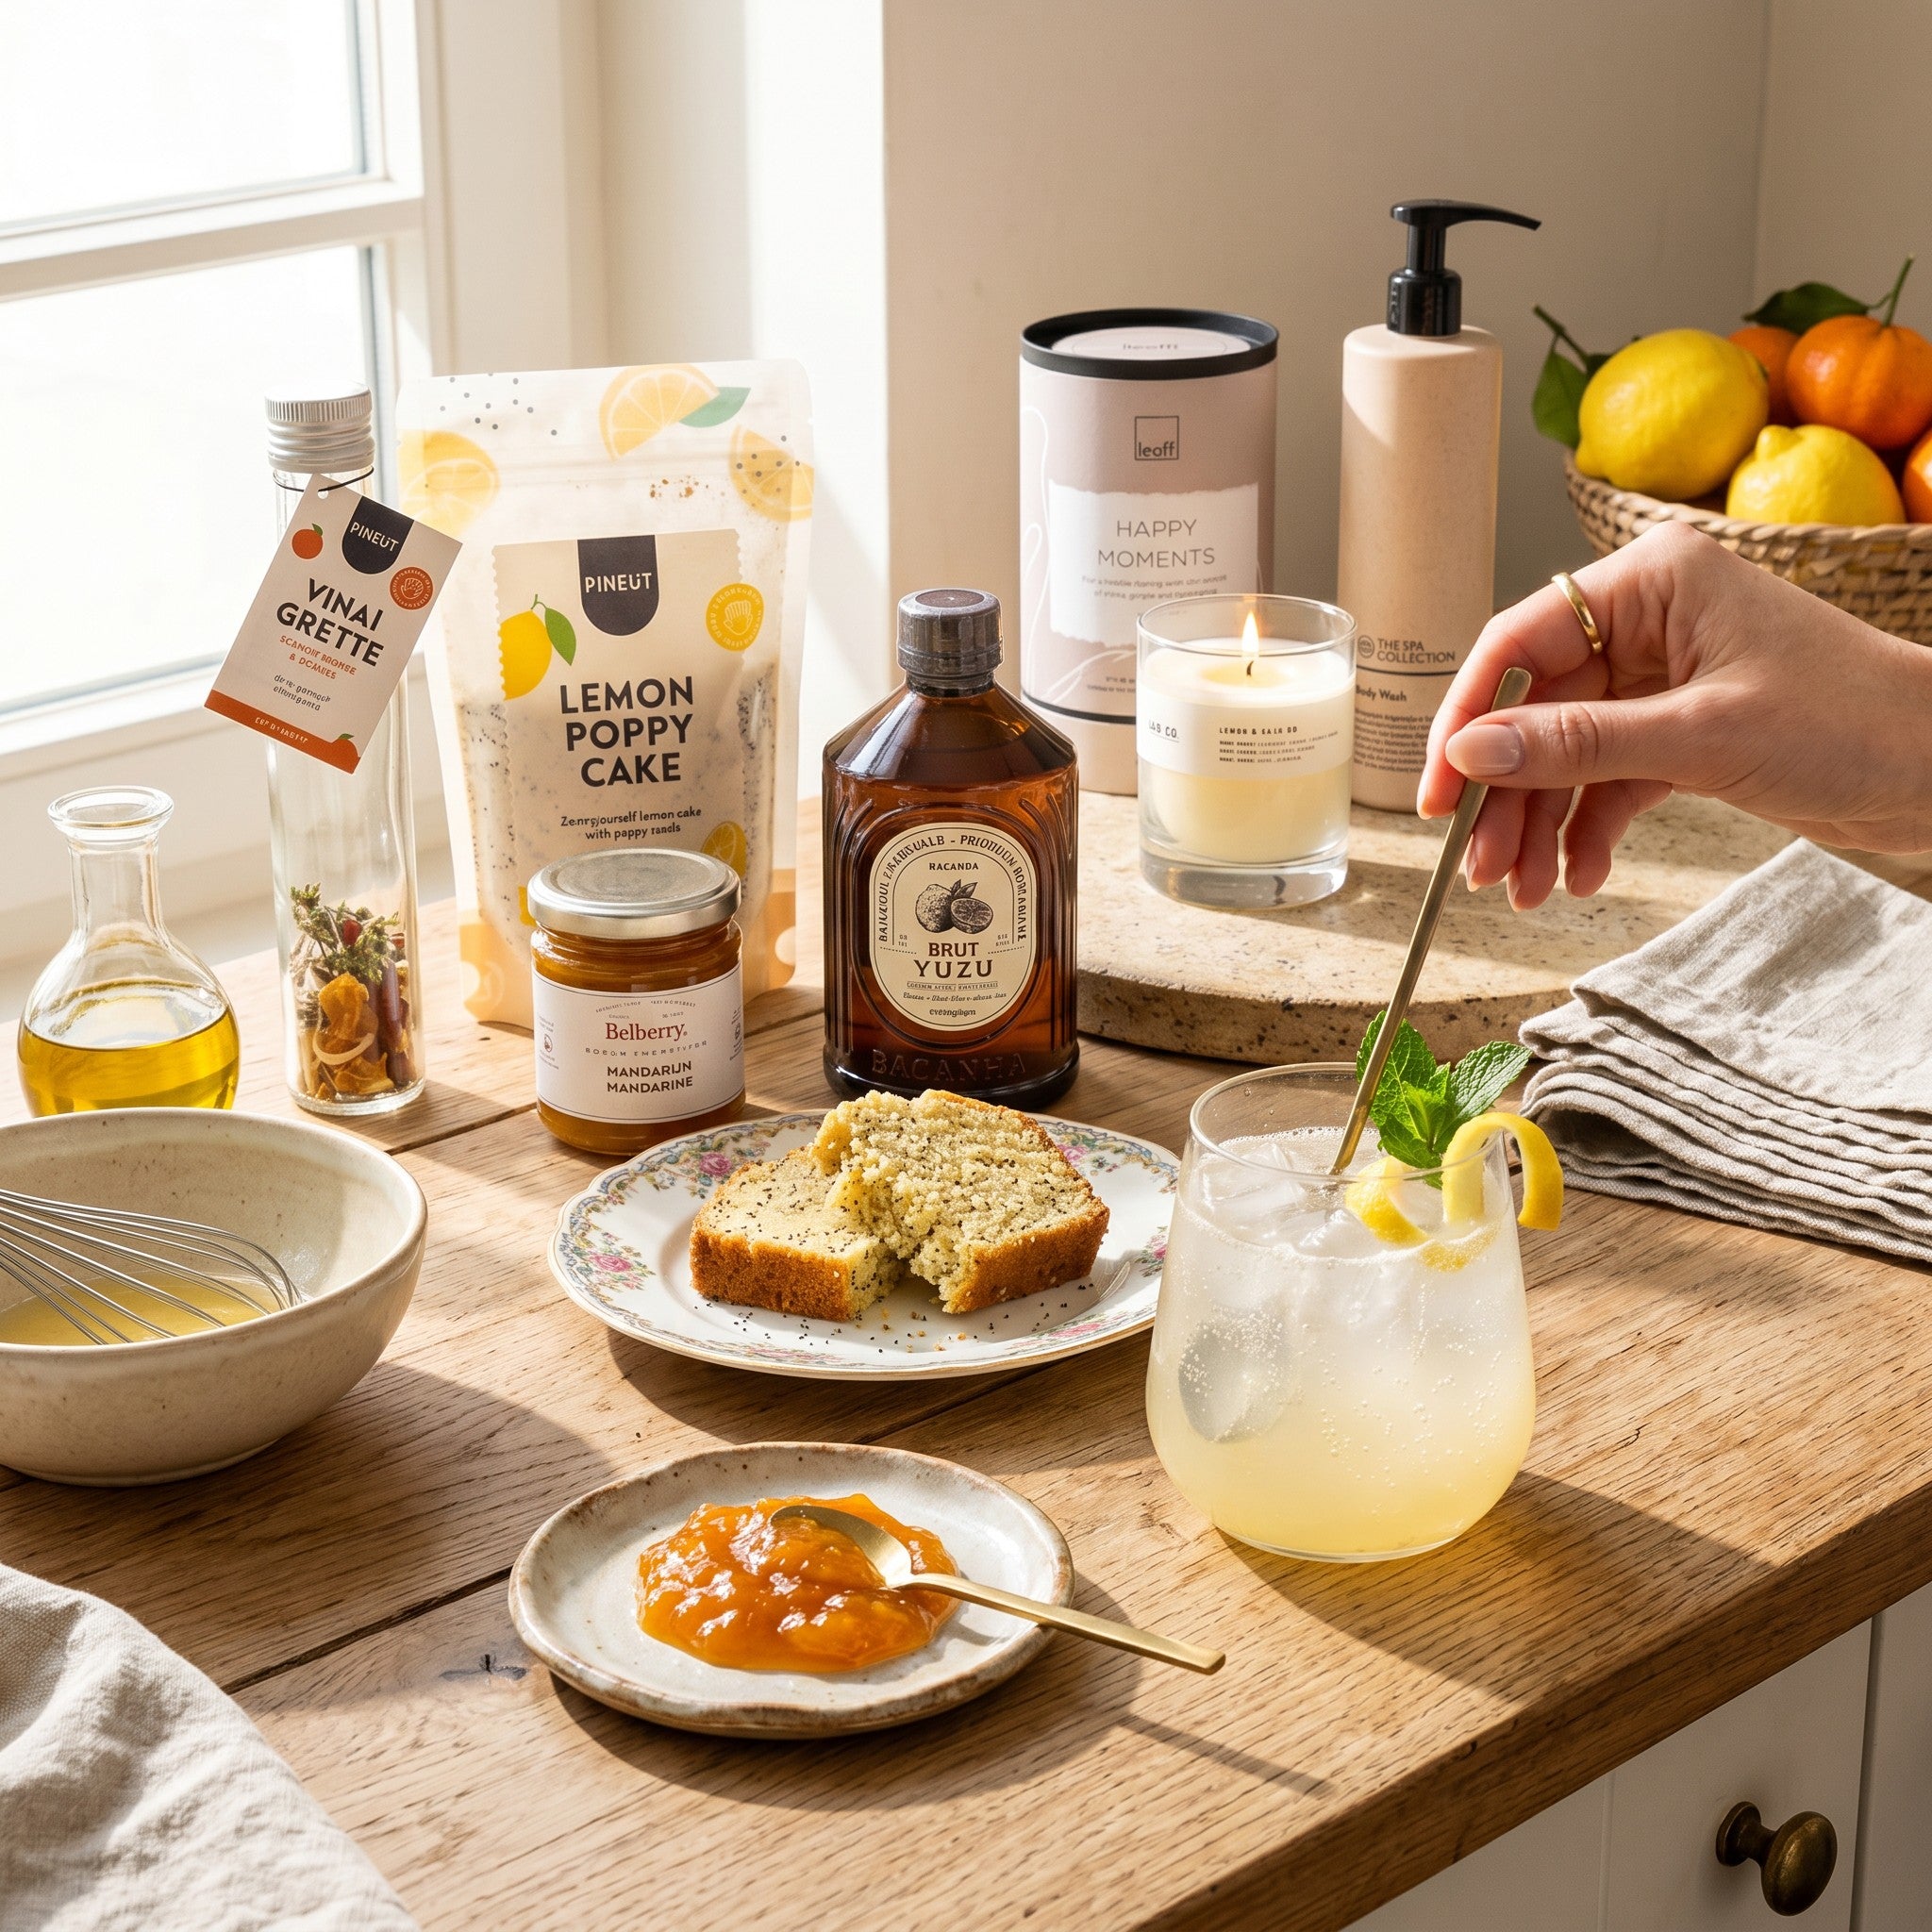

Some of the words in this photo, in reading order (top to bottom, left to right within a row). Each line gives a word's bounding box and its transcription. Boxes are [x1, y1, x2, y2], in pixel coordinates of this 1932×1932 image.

[1138, 441, 1175, 458] leoff
[1116, 519, 1197, 539] HAPPY
[1097, 547, 1215, 568] MOMENTS
[308, 577, 384, 632] VINAI
[276, 602, 385, 667] GRETTE
[1377, 638, 1400, 651] THE
[1403, 641, 1424, 651] SPA
[1376, 651, 1456, 664] COLLECTION
[560, 675, 693, 715] LEMON
[1379, 690, 1407, 702] Wash
[566, 713, 693, 751] POPPY
[581, 752, 682, 787] CAKE
[640, 810, 675, 823] lemon
[676, 806, 702, 819] cake
[585, 828, 611, 840] with
[614, 828, 648, 841] pappy
[928, 941, 979, 957] BRUT
[913, 959, 993, 979] YUZU
[608, 1060, 691, 1077] MANDARIJN
[608, 1076, 692, 1093] MANDARINE
